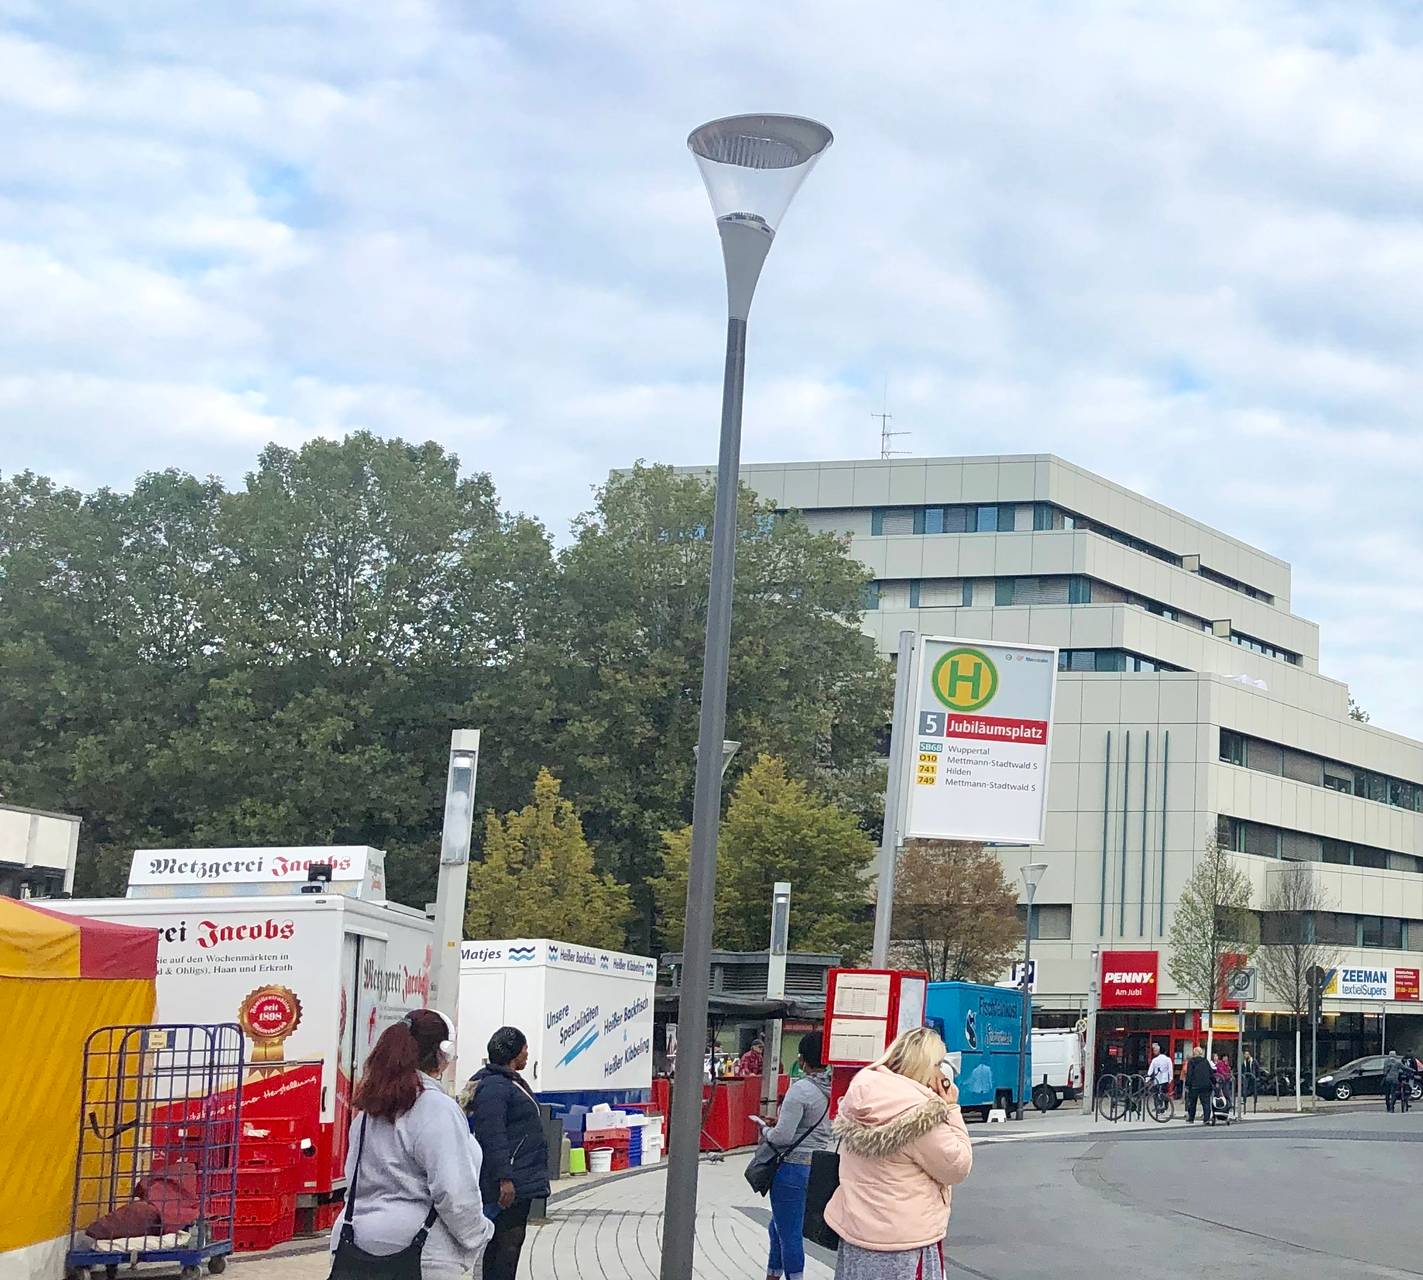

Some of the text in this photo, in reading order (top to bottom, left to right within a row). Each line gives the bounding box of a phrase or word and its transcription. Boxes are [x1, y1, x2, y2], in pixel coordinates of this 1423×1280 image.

[948, 660, 982, 700] H
[925, 714, 937, 734] 5
[948, 720, 1043, 740] Jubiläumsplatz
[948, 745, 990, 755] Wuppertal
[947, 757, 1031, 769] Mettmann-Stadtwald
[946, 768, 972, 776] Hilden
[917, 777, 1036, 792] 749 Mettmann-Stadtwald S
[149, 856, 264, 878] Metzgerei
[271, 855, 352, 877] Jacbs
[195, 918, 296, 949] Jacobs
[169, 955, 186, 964] auf
[186, 955, 203, 964] den
[206, 954, 277, 963] Wochenmärkten
[280, 953, 289, 961] in
[461, 949, 502, 963] Matjes
[560, 951, 575, 964] Heißer
[165, 967, 173, 976] &
[213, 966, 237, 974] Haan
[240, 965, 257, 973] und
[259, 964, 293, 973] Erkrath
[1342, 969, 1387, 983] ZEEMAN
[1115, 987, 1142, 996] Am Jubi
[1342, 984, 1387, 997] textielSupers
[546, 1004, 570, 1030] Unsere
[603, 993, 649, 1036] Heißer Backfisch
[559, 1004, 600, 1046] Spezialitäten
[604, 1037, 650, 1079] Heißer Kibbeling
[263, 1075, 318, 1099] Herstellung
